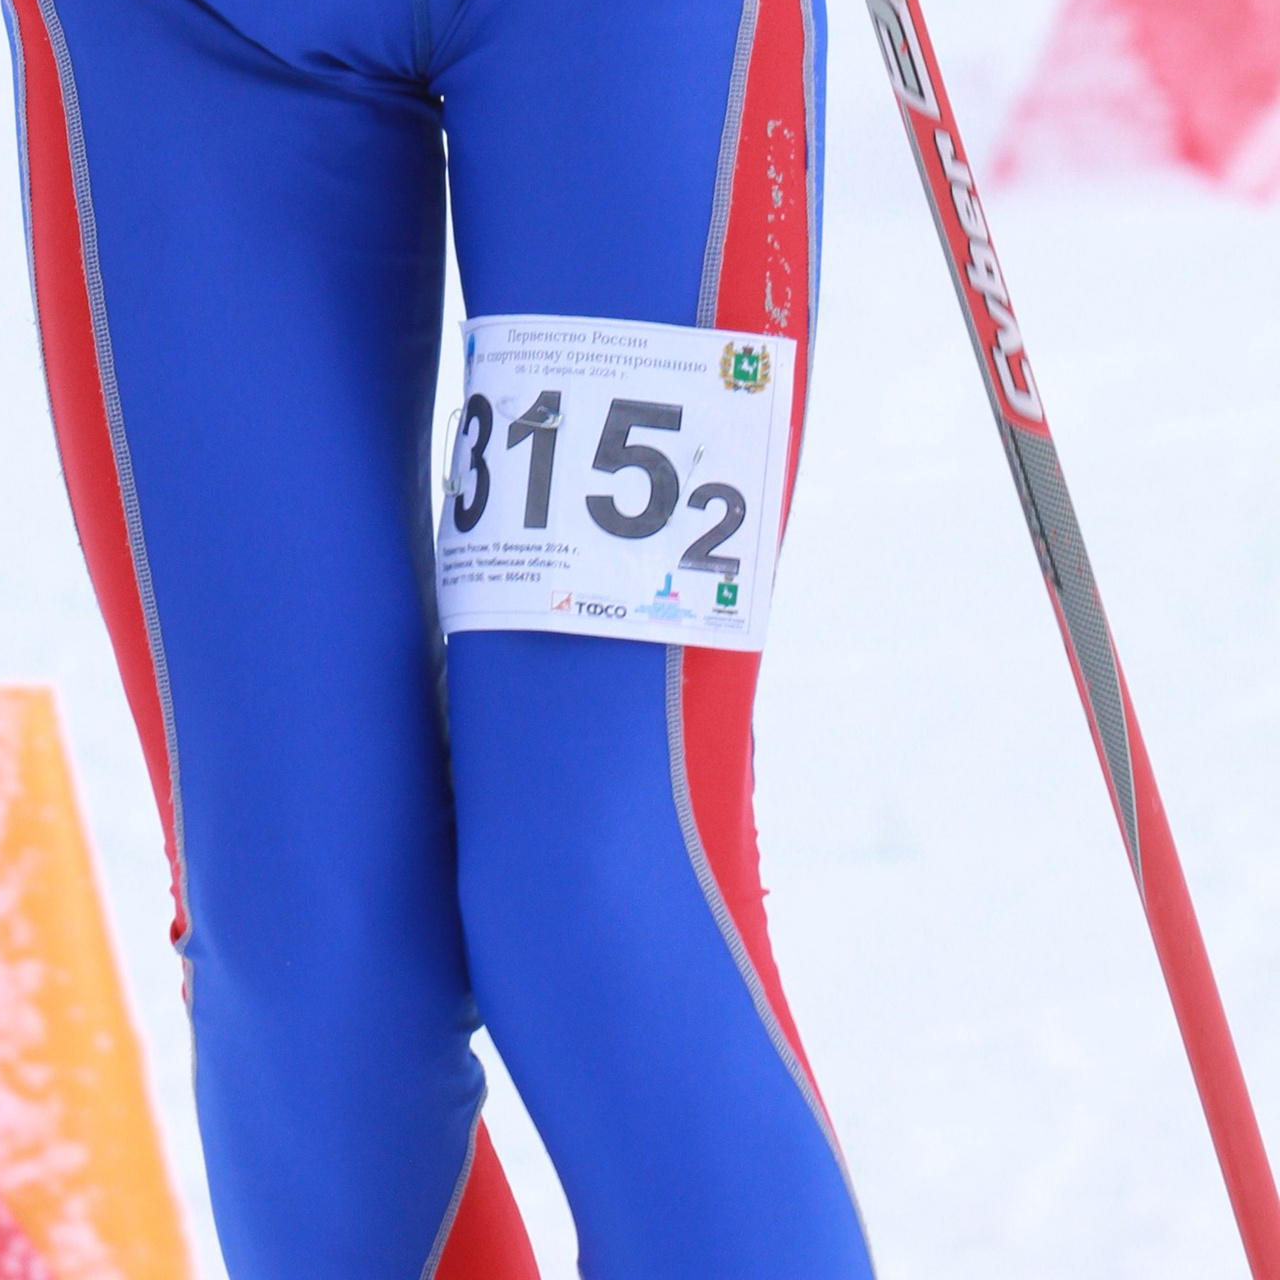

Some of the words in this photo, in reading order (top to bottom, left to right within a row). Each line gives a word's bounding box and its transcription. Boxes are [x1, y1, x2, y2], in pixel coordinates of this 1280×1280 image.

[508, 328, 586, 345] Первенство
[591, 330, 648, 349] России
[486, 347, 562, 364] спортивному
[566, 351, 708, 374] ориентированию
[589, 367, 616, 378] 2024
[453, 390, 684, 540] 315
[677, 482, 747, 576] 2
[575, 600, 627, 619] ТФСО
